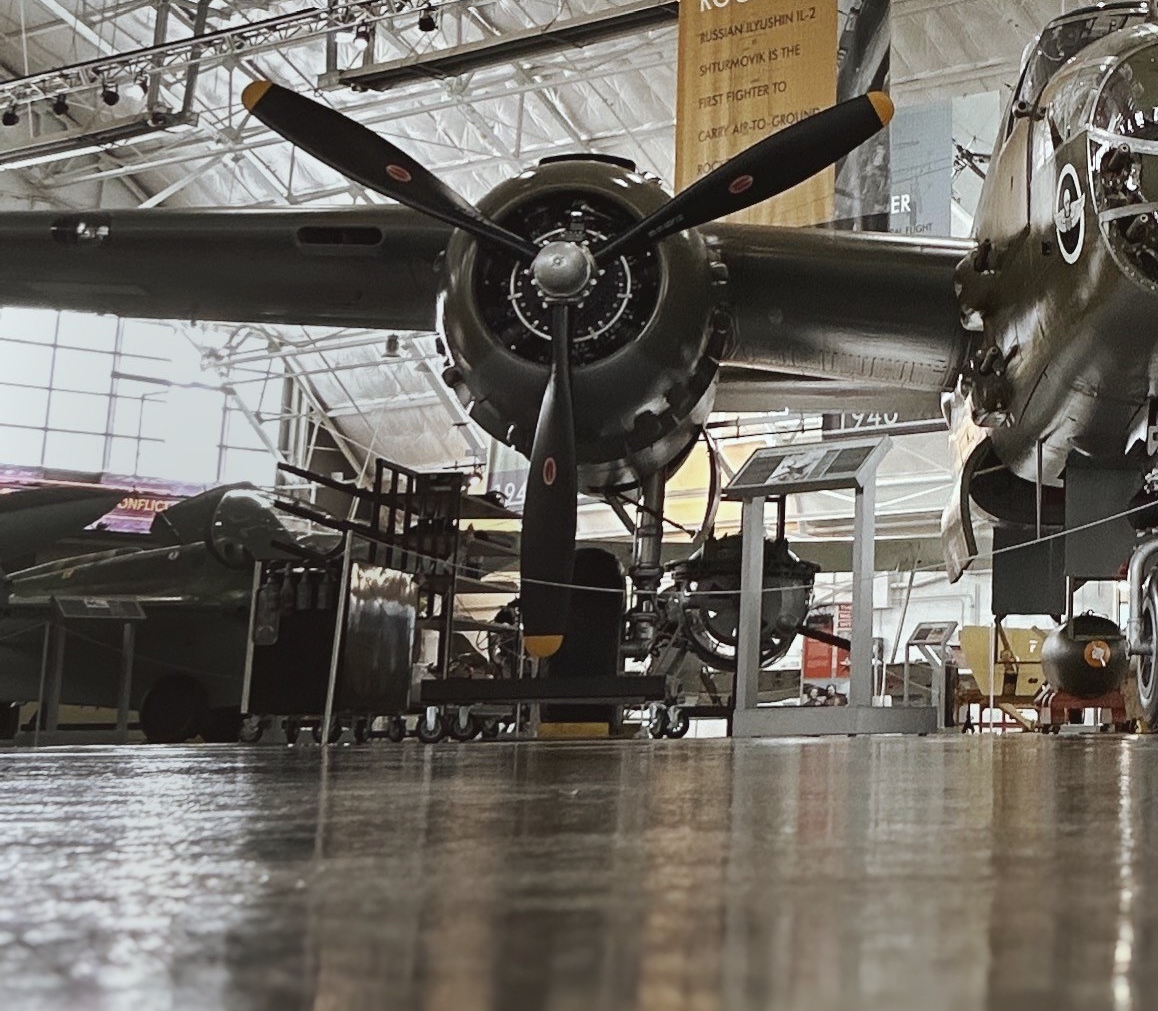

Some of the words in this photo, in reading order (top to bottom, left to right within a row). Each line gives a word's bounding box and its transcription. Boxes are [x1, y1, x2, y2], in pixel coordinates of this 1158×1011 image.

[699, 24, 743, 44] RUSSIAN
[744, 14, 794, 35] ILYUSHIN
[796, 7, 817, 24] IL-2
[699, 52, 765, 77] SHTURMOVIK
[768, 48, 779, 63] IS
[781, 44, 801, 58] THE
[697, 93, 723, 110] FIRST
[726, 84, 770, 106] FIGHTER
[771, 81, 787, 95] TO
[697, 126, 729, 143] CARRY
